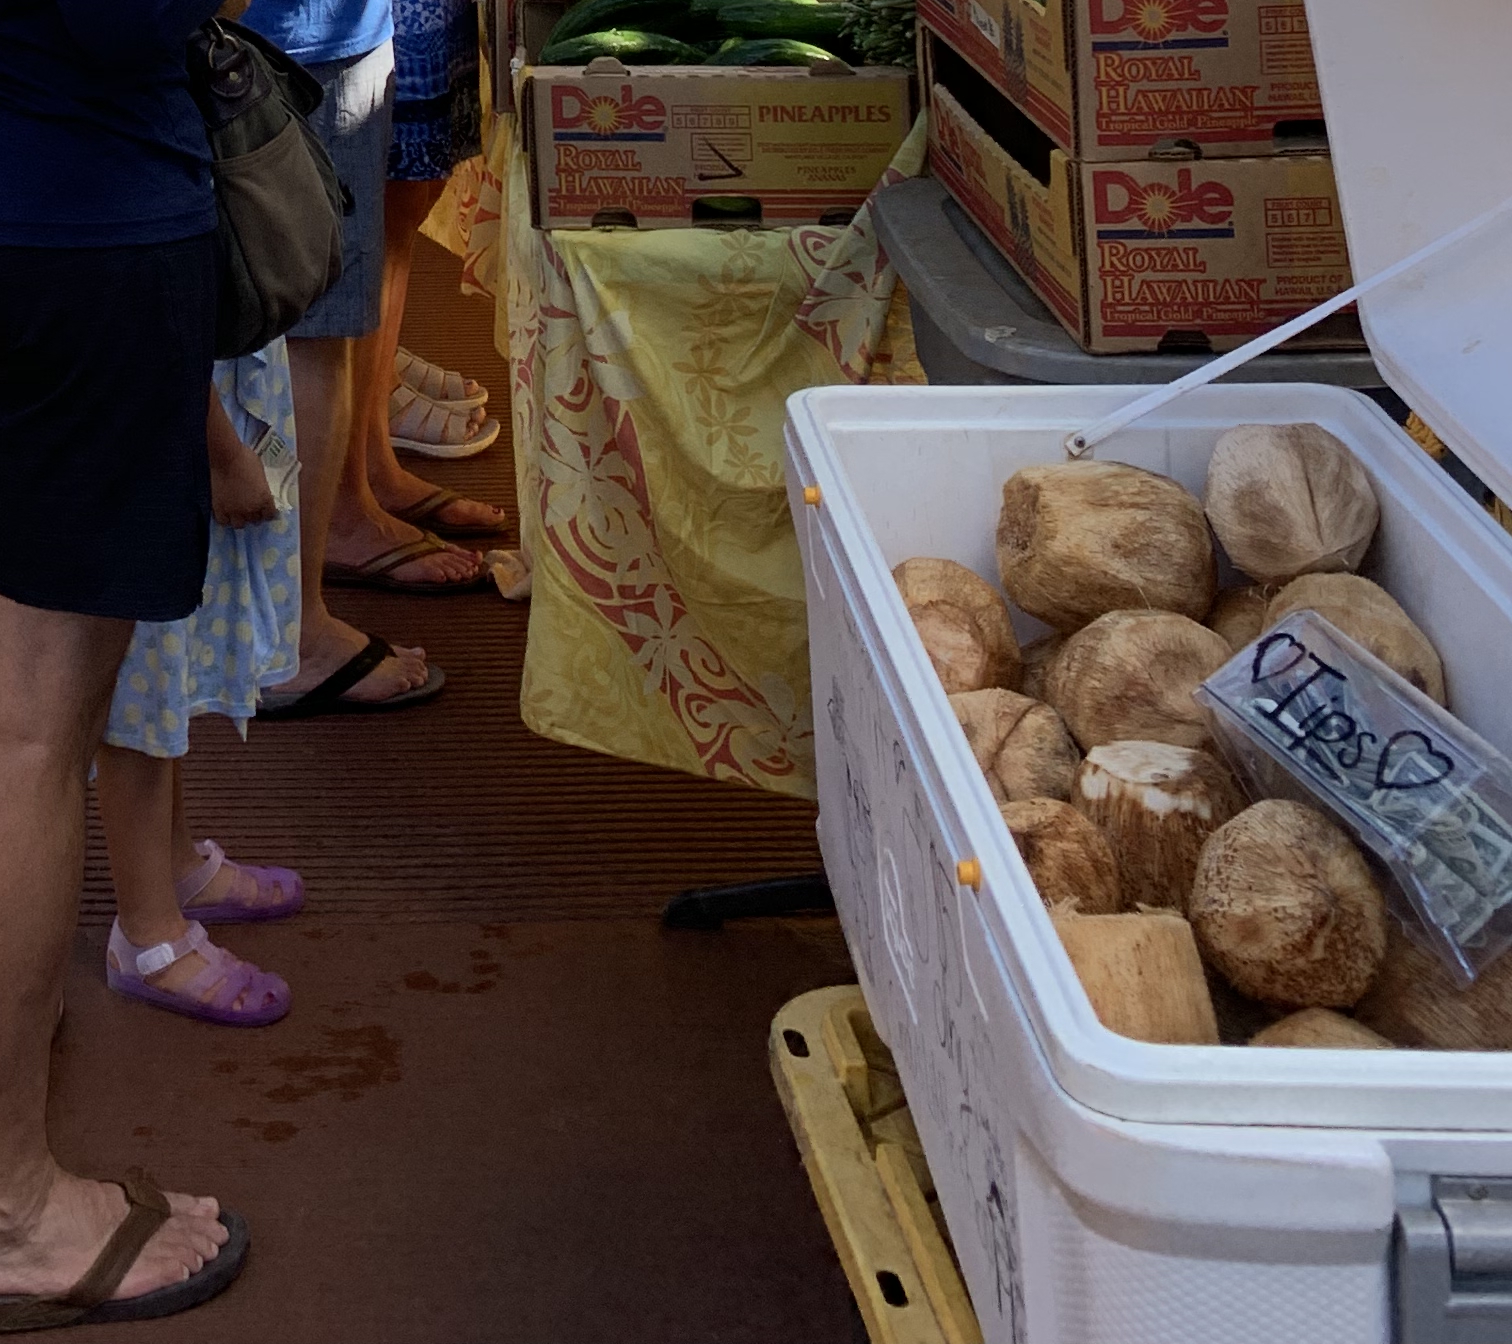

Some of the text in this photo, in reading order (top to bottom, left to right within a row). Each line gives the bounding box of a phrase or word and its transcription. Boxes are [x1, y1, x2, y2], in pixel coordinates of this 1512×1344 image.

[1095, 52, 1201, 82] ROYAL
[1096, 83, 1260, 113] HAWAIIAN
[1270, 82, 1318, 92] PRODUC
[551, 85, 666, 135] Dole
[758, 105, 891, 123] PINEAPPLES
[1099, 115, 1154, 132] Tropical
[1197, 111, 1258, 129] Pineapple
[555, 143, 641, 172] ROYAL
[556, 170, 686, 196] HAWAIIAN
[1093, 168, 1234, 232] Dole
[1303, 213, 1311, 222] 7
[1097, 240, 1206, 273] ROYAL
[1099, 274, 1266, 303] HAWAIIAN
[1276, 274, 1344, 285] PRODUCT OF
[1104, 307, 1158, 322] Tropical
[1202, 306, 1265, 323] Pineapple
[1254, 651, 1377, 769] Tips
